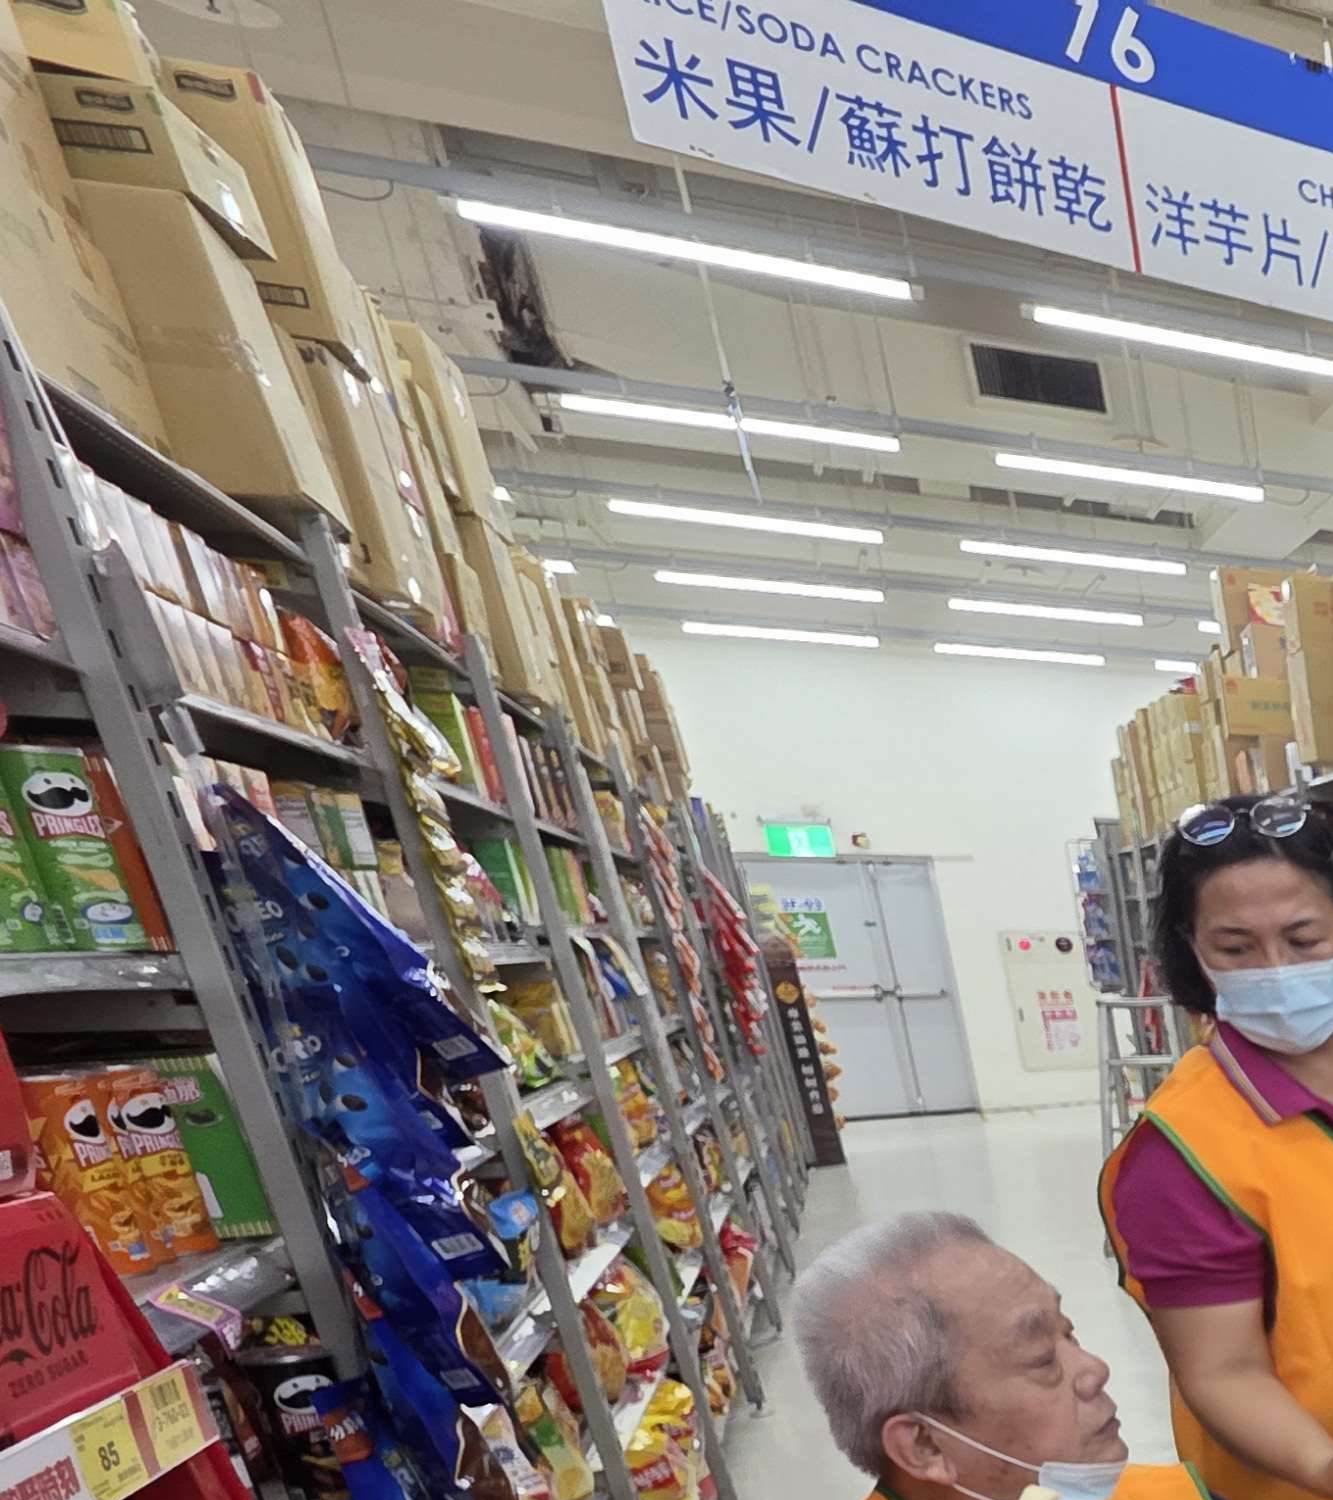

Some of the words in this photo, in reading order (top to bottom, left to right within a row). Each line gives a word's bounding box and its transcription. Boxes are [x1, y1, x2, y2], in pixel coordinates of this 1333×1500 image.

[1065, 0, 1157, 83] 16
[856, 43, 1035, 121] CRACKERS
[633, 37, 1113, 233] 米果/蘇打餅乾
[98, 1441, 121, 1473] 85
